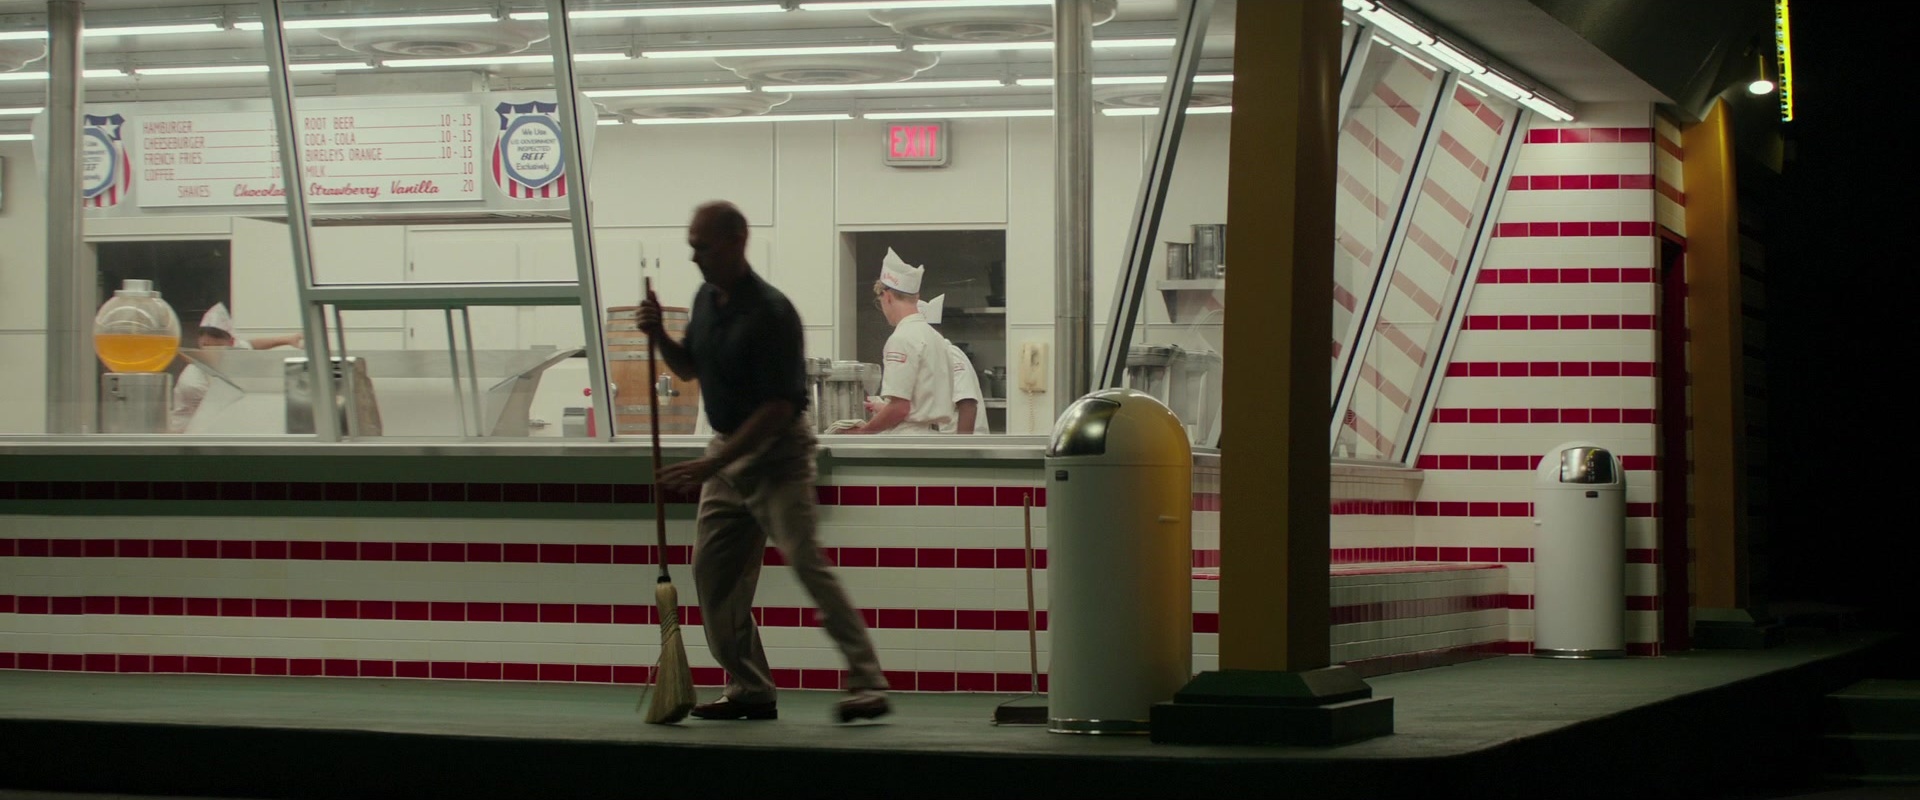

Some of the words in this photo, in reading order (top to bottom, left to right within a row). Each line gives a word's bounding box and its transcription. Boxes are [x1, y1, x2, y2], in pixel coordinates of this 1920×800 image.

[143, 121, 192, 134] HAMBURGER
[305, 117, 327, 129] ROOT
[334, 116, 354, 129] BEER
[144, 136, 204, 149] CHEESEBURGER
[890, 126, 939, 158] EXIT
[144, 152, 175, 166] FRENCH
[180, 151, 202, 165] FRIES
[349, 147, 382, 161] ORANGE
[521, 152, 546, 160] BEEF
[306, 164, 326, 178] MILK
[516, 163, 549, 171] Exclusively
[144, 168, 175, 182] COFFEE
[177, 184, 209, 199] SHAKES
[391, 179, 440, 195] Vanilla
